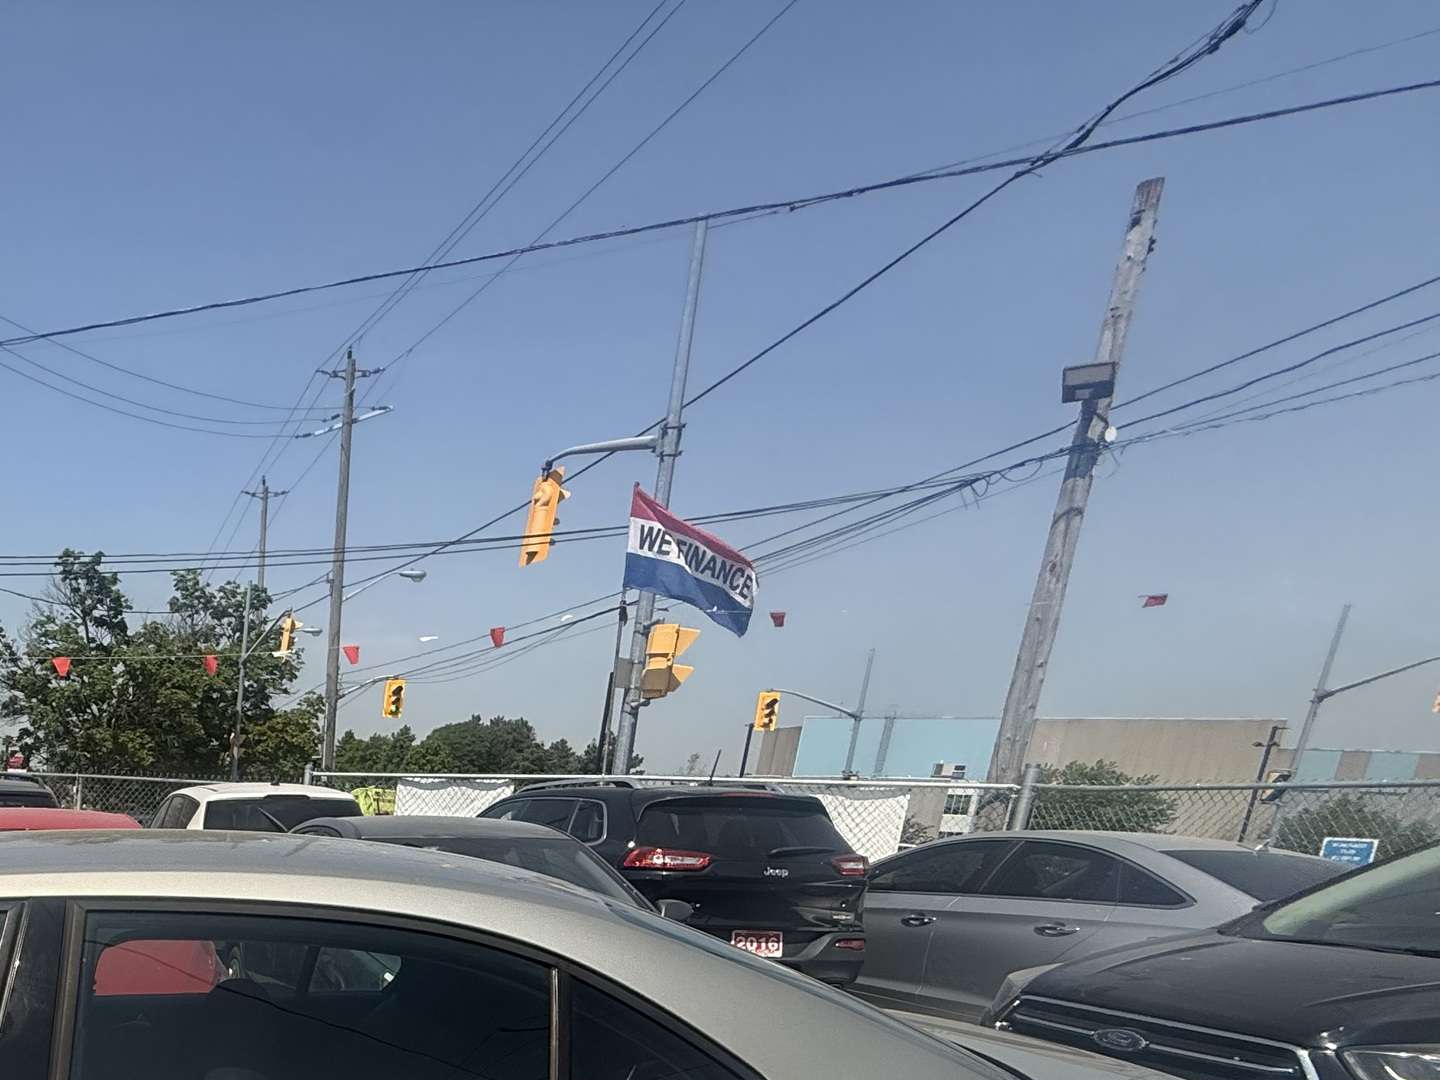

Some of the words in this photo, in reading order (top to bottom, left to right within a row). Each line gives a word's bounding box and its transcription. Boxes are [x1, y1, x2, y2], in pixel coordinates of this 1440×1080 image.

[639, 524, 672, 556] WE
[676, 538, 753, 599] FINANCE
[763, 866, 789, 878] Jeep
[735, 936, 779, 953] 2016
